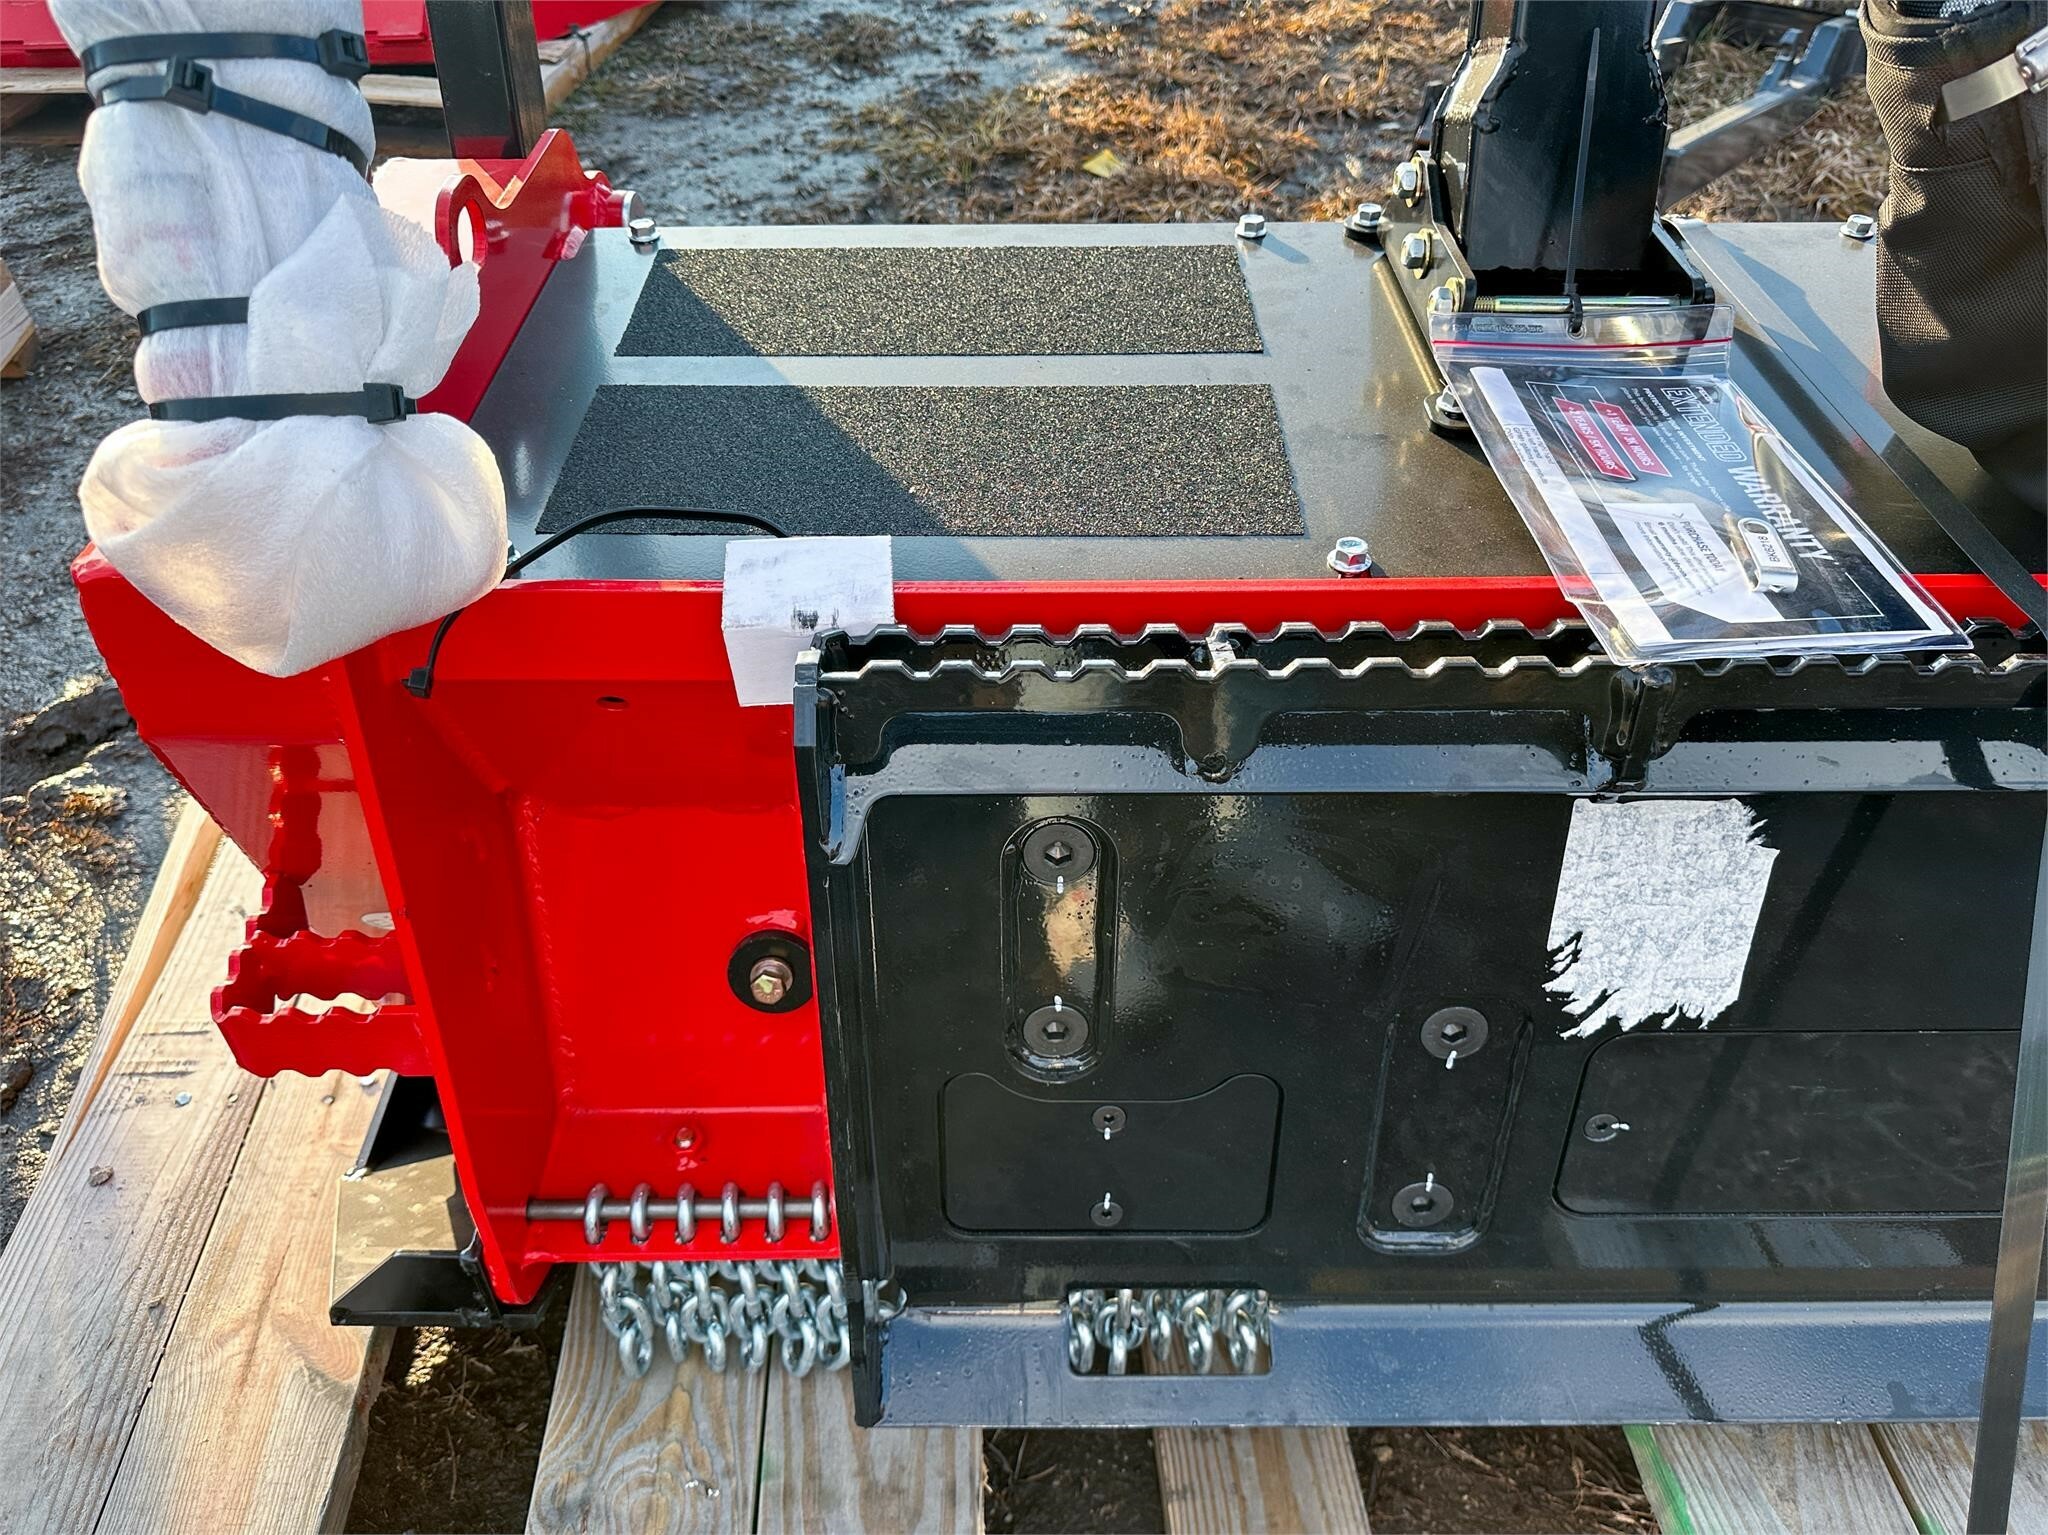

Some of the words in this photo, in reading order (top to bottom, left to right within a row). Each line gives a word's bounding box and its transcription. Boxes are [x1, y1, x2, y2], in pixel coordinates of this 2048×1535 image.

[1571, 415, 1595, 434] YEARS
[1607, 416, 1630, 431] YEAR
[1660, 387, 1748, 463] EXTENDED
[1587, 439, 1605, 448] 5K
[1622, 436, 1639, 445] 3K
[1664, 417, 1682, 430] YOUR
[1675, 430, 1707, 461] INVESTMENT
[1593, 449, 1619, 469] HOURS
[1628, 445, 1655, 465] HOURS
[1678, 521, 1712, 551] PURCHASE
[1701, 552, 1727, 572] TODAY
[1758, 535, 1781, 563] BK6218
